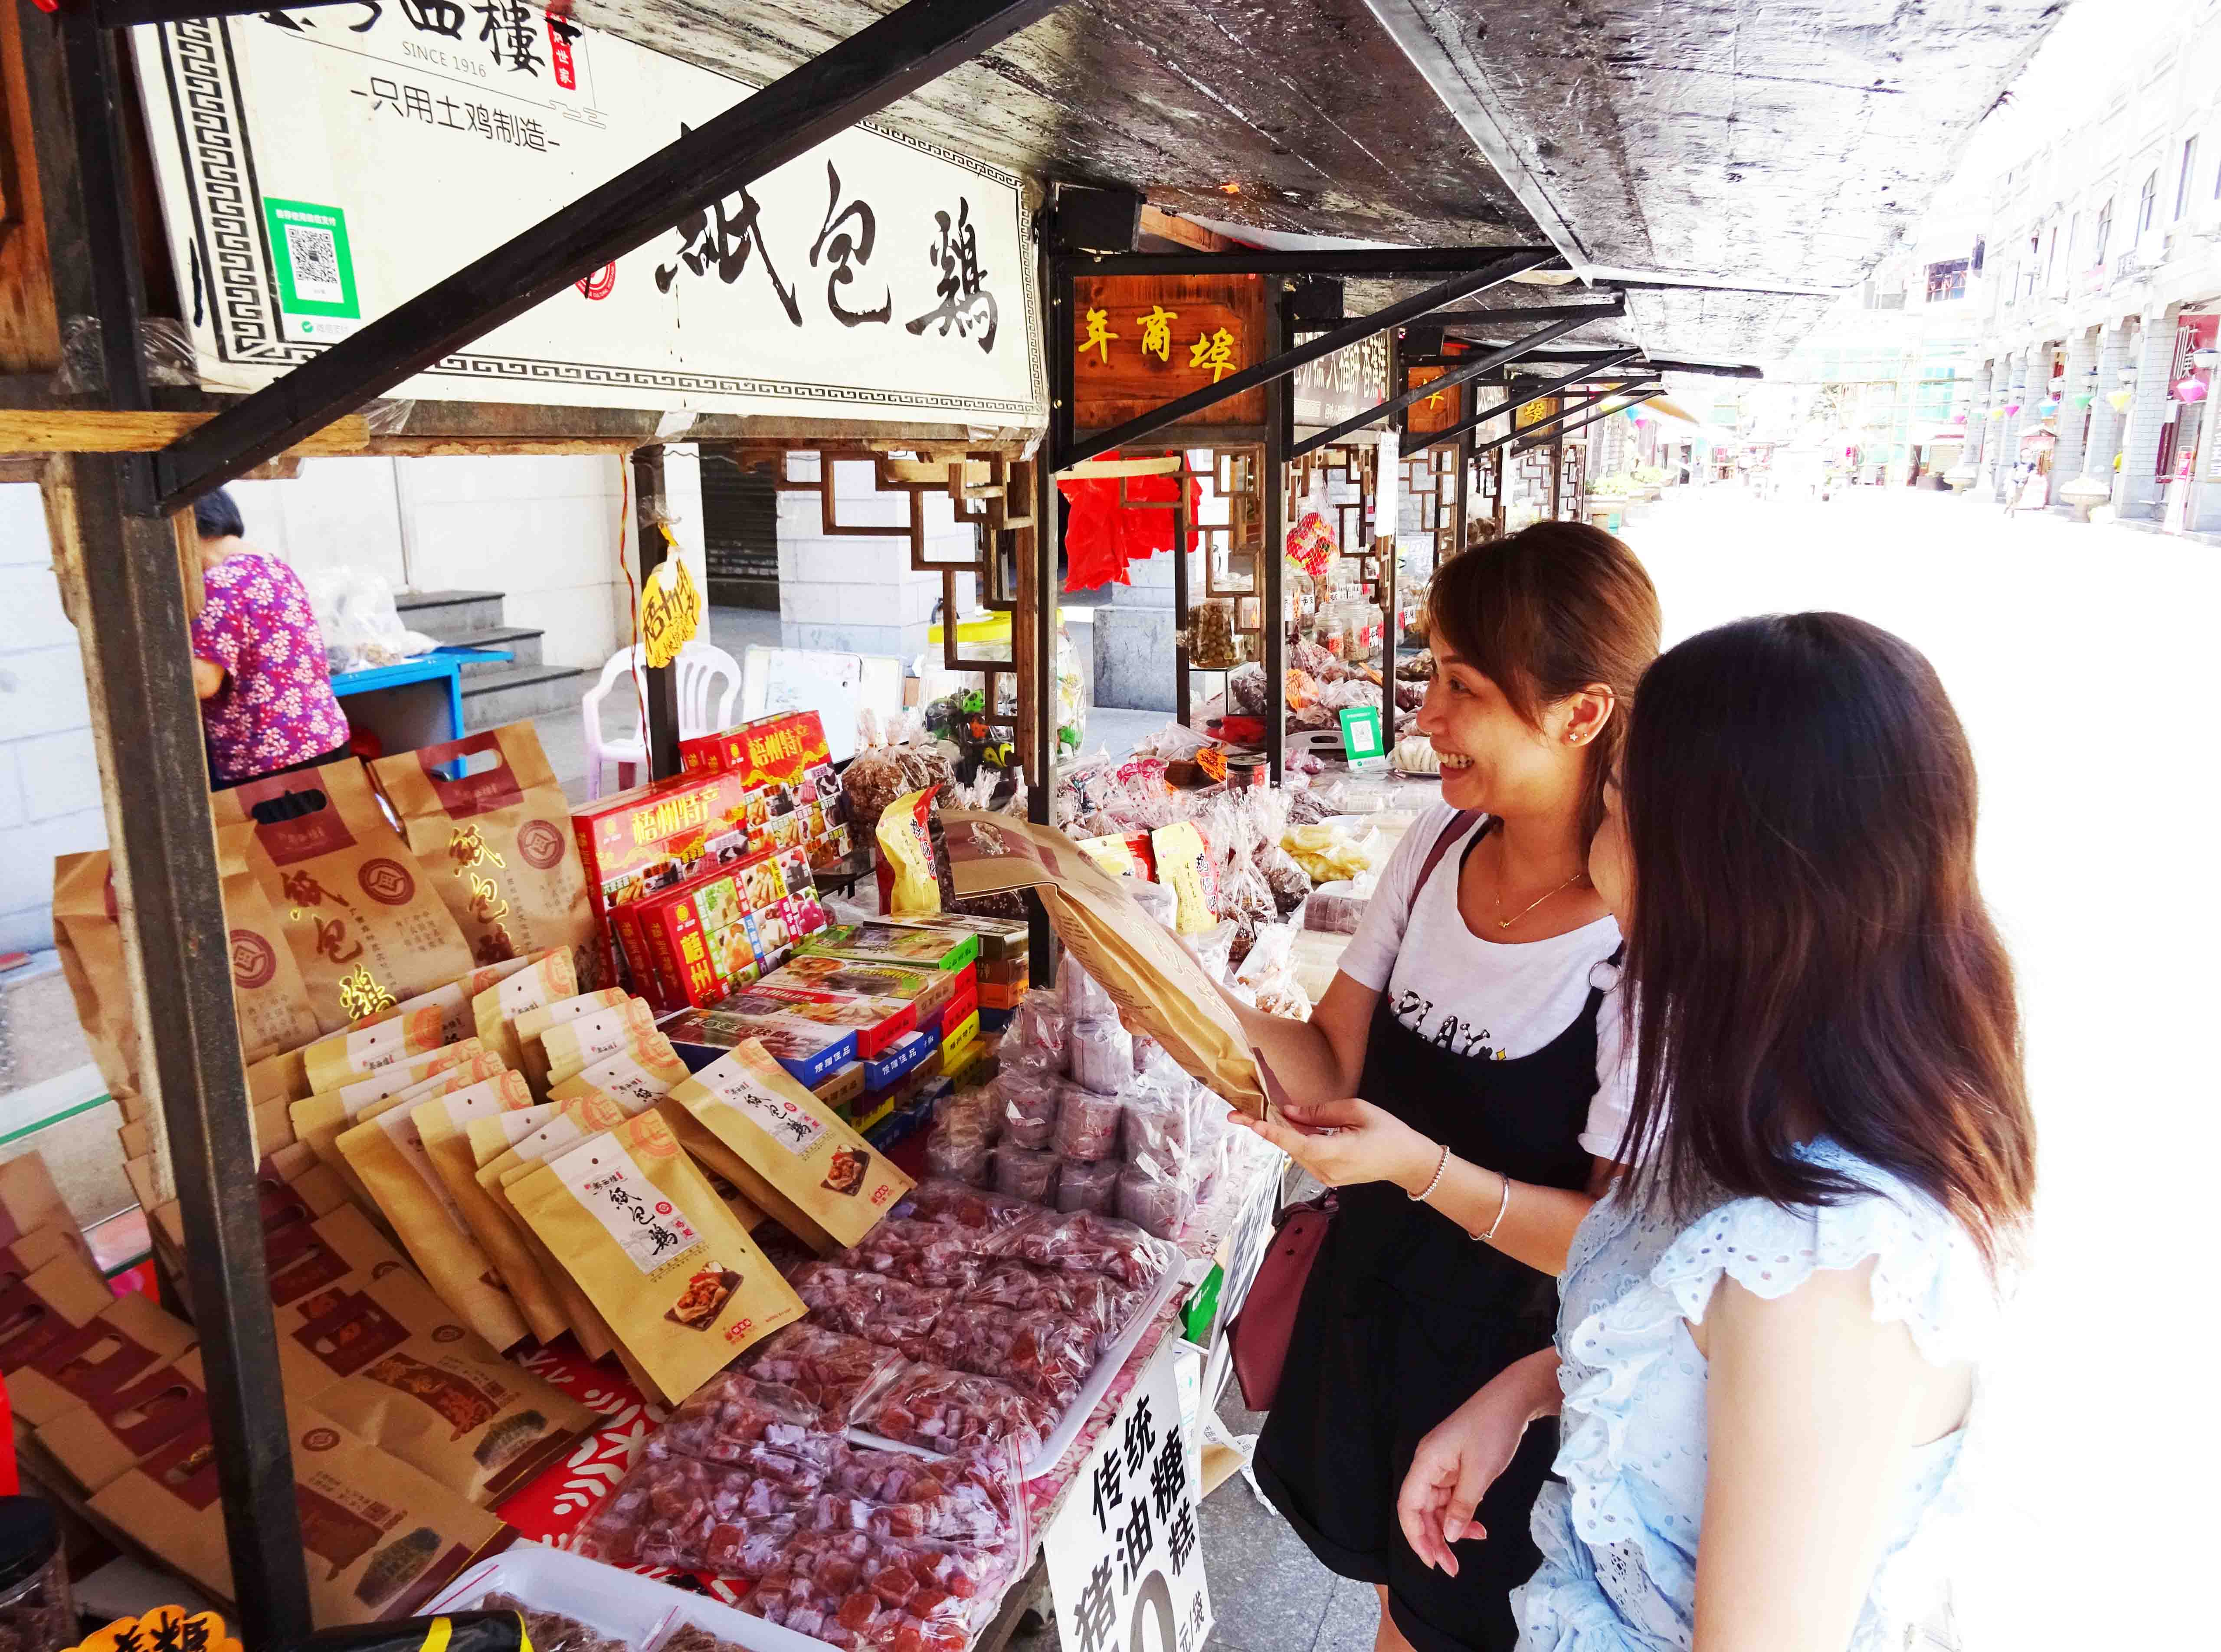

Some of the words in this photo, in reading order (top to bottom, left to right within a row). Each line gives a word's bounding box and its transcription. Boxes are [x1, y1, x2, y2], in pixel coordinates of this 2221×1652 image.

[401, 41, 447, 67] SINCE
[452, 56, 487, 78] 1916
[748, 724, 809, 767] 梧州特产
[631, 787, 721, 845] 梧州特产
[1093, 1393, 1156, 1534] 传统
